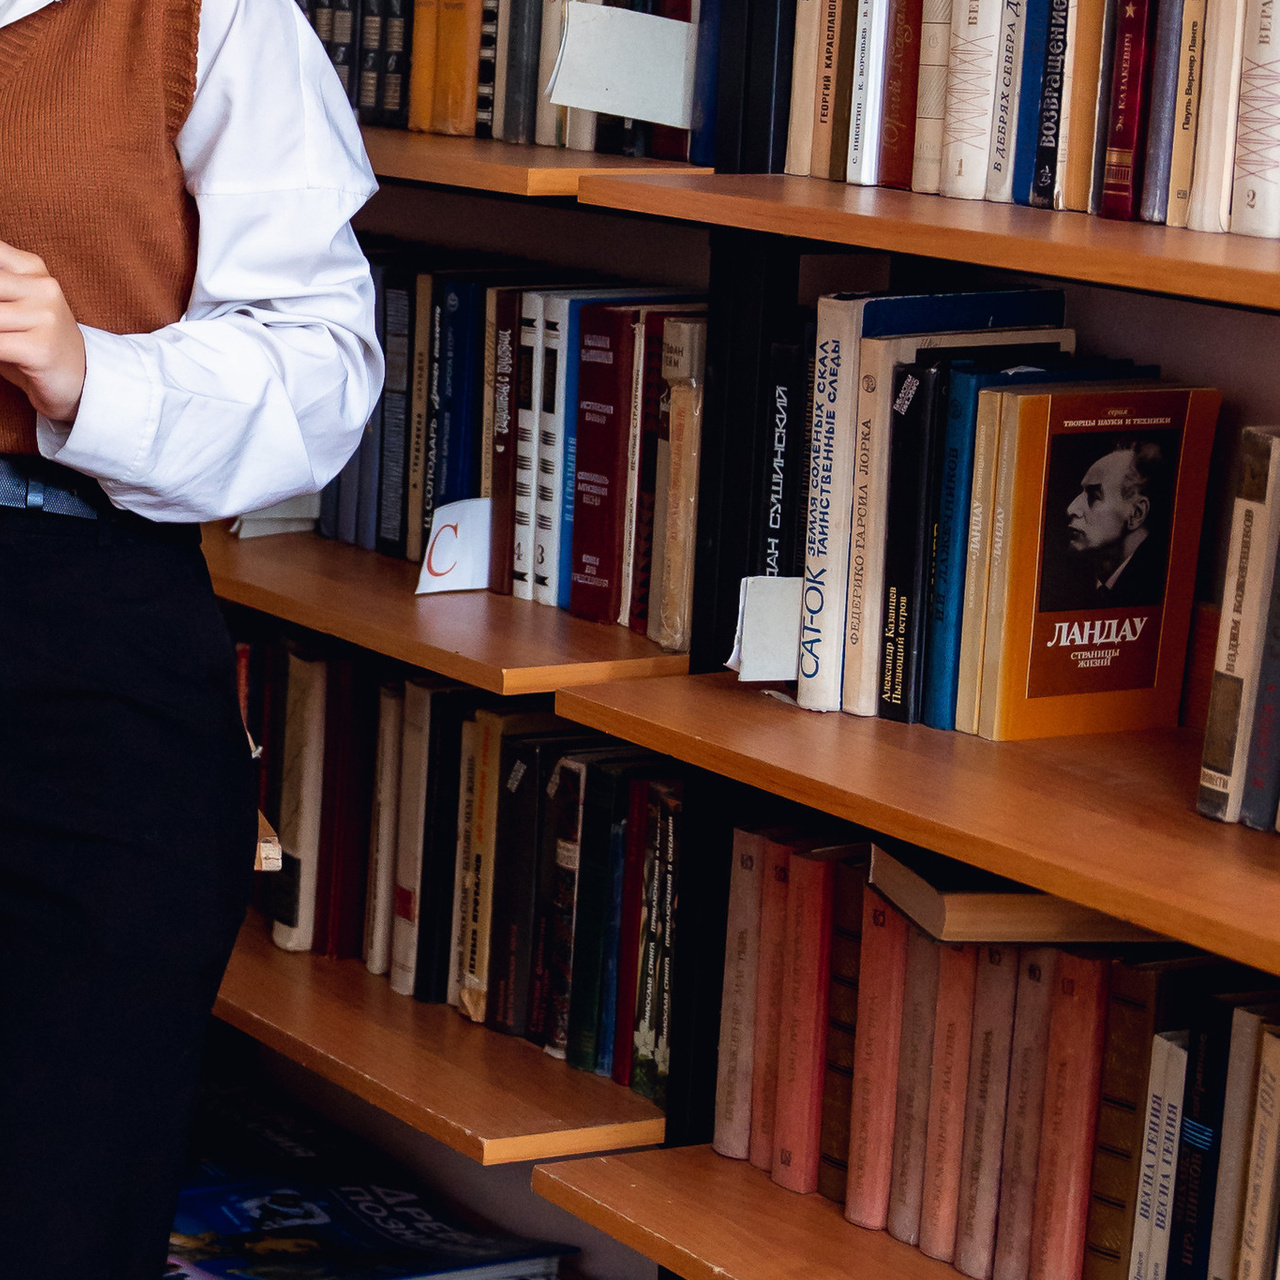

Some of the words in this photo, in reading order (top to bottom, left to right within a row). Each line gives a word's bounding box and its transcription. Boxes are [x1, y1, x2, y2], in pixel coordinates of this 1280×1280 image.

[862, 9, 868, 18] В.
[1187, 21, 1198, 52] Ланге
[1257, 0, 1275, 45] ВЕРА
[859, 27, 867, 77] ВОРОБЬЕВ
[1002, 22, 1016, 87] СЕВЕРА
[1119, 33, 1133, 110] КАЗАКЕВИЧ
[1184, 56, 1197, 96] Вернер
[819, 75, 831, 124] ГЕОРГИЙ
[853, 102, 862, 151] НИКИТИН
[995, 92, 1010, 158] ДЕБРЯХ
[1181, 99, 1193, 130] Пауль
[993, 161, 1002, 173] В
[1246, 189, 1257, 209] 2
[816, 340, 829, 393] СКАЛ
[810, 403, 824, 489] СОЛЕНЫХ
[817, 410, 836, 557] ТАИНСТВЕННЫЕ
[827, 339, 841, 403] СЛЕДЫ
[1063, 420, 1096, 428] ТВОРЦЫ
[1097, 418, 1123, 426] НАУКИ
[1133, 417, 1171, 425] ТЕХНИКИ
[424, 418, 438, 510] СОЛОДАРЬ
[768, 385, 788, 529] СУШИНСКИЙ
[426, 523, 459, 578] С
[807, 497, 818, 557] ЗЕМЛЯ
[849, 556, 864, 645] ФЕДЕРИКО
[859, 419, 872, 475] ЛОРКА
[969, 500, 982, 556] ЛАНДАУ
[994, 506, 1004, 563] ЛАНДАУ
[801, 565, 827, 679] САТ-ОК
[886, 587, 897, 638] Казанцев
[897, 596, 907, 633] остров
[1047, 616, 1148, 647] ЛАНДАУ
[882, 642, 895, 702] Александр
[893, 637, 906, 704] Пылающий
[1071, 649, 1120, 660] СТРАНИЦЫ
[1078, 657, 1111, 668] ЖИЗНИ
[651, 860, 660, 932] ПРИКЛЮЧЕНИЯ
[665, 874, 673, 947] ПРИКЛЮЧЕНИЯ
[1144, 1094, 1162, 1156] ГЕНИЯ
[1160, 1103, 1178, 1167] ГЕНИЯ
[1139, 1161, 1156, 1220] ВЕСНА
[1155, 1173, 1172, 1230] ВЕСНА
